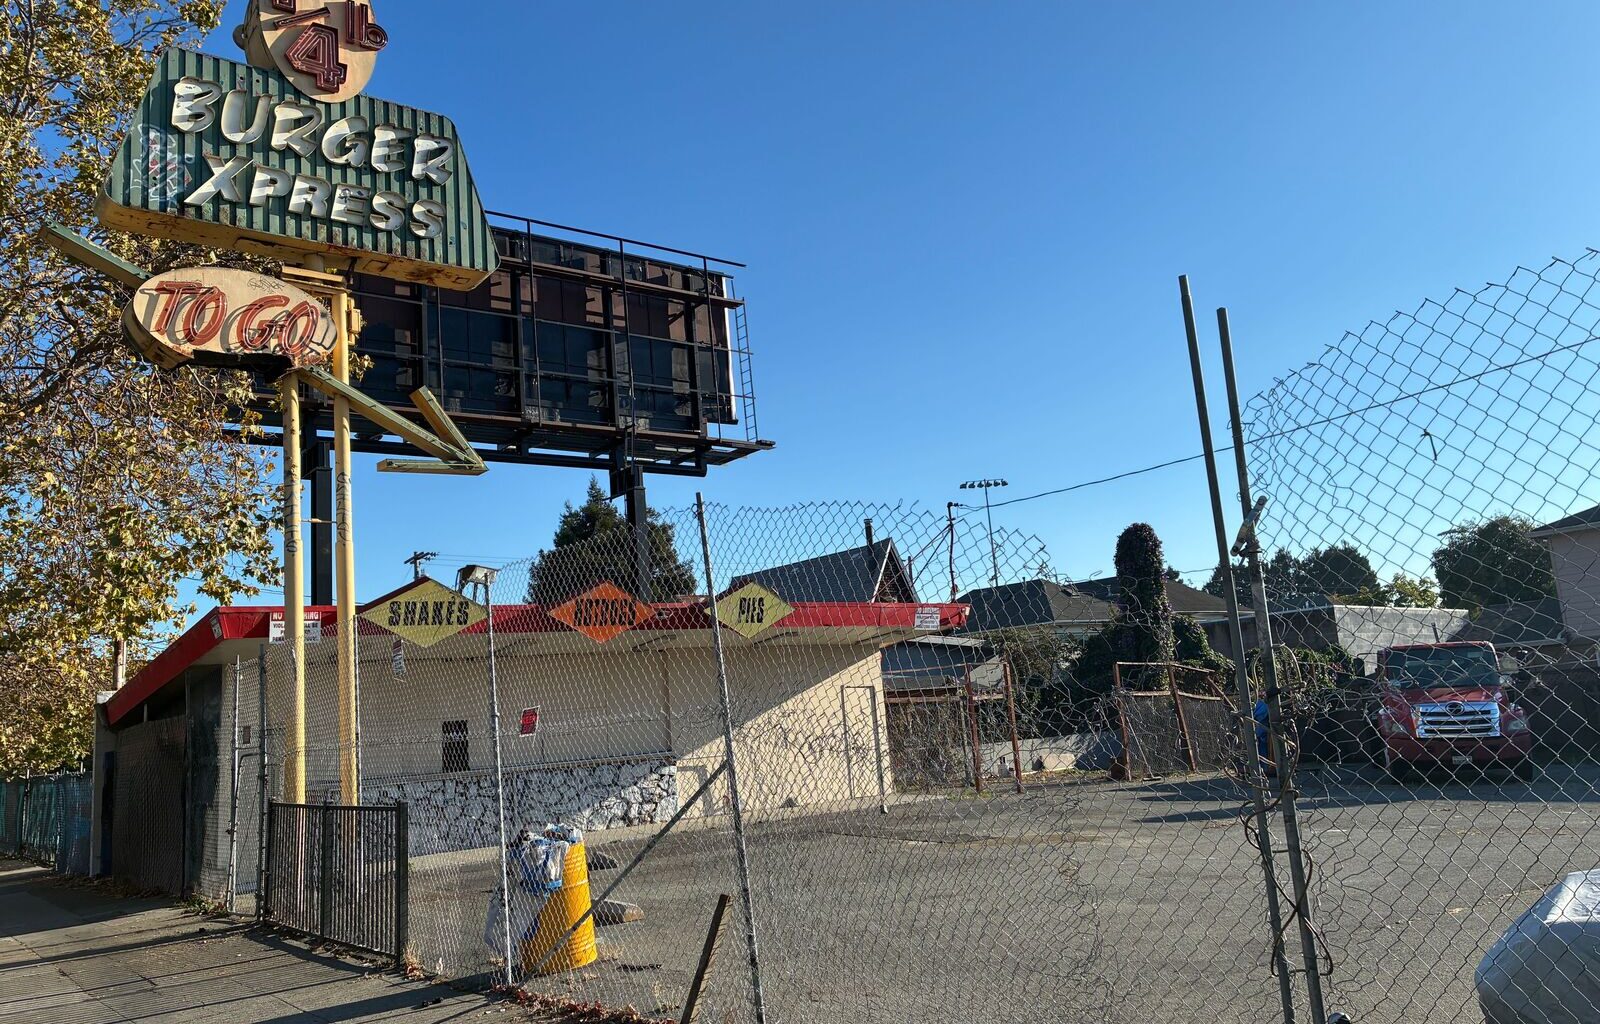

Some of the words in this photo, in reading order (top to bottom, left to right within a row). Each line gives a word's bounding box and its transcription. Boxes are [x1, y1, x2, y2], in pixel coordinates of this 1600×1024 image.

[171, 76, 455, 187] BURGER
[184, 151, 447, 239] XPRESS
[155, 280, 228, 346] TO
[236, 294, 321, 357] GO
[272, 611, 283, 620] NO
[388, 600, 469, 626] SHAKES
[737, 597, 765, 623] PIES
